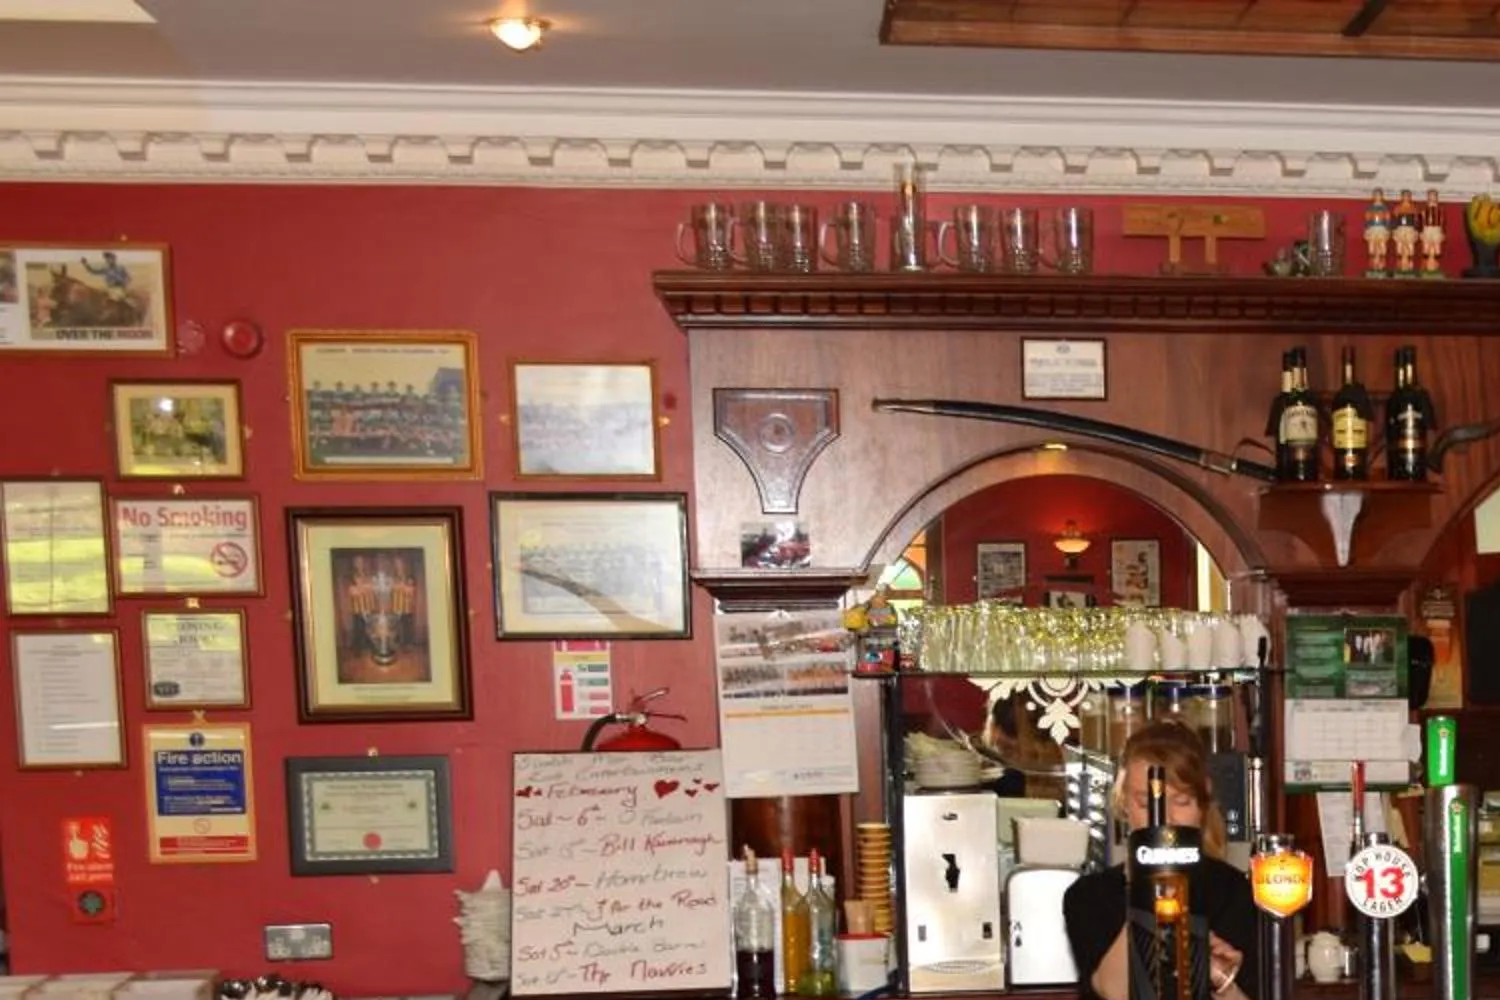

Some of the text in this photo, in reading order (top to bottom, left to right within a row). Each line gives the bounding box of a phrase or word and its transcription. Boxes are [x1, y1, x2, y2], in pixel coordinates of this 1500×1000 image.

[92, 329, 113, 340] THE
[122, 505, 247, 531] No Smoking
[157, 751, 242, 765] Fire action
[1358, 867, 1405, 898] 13
